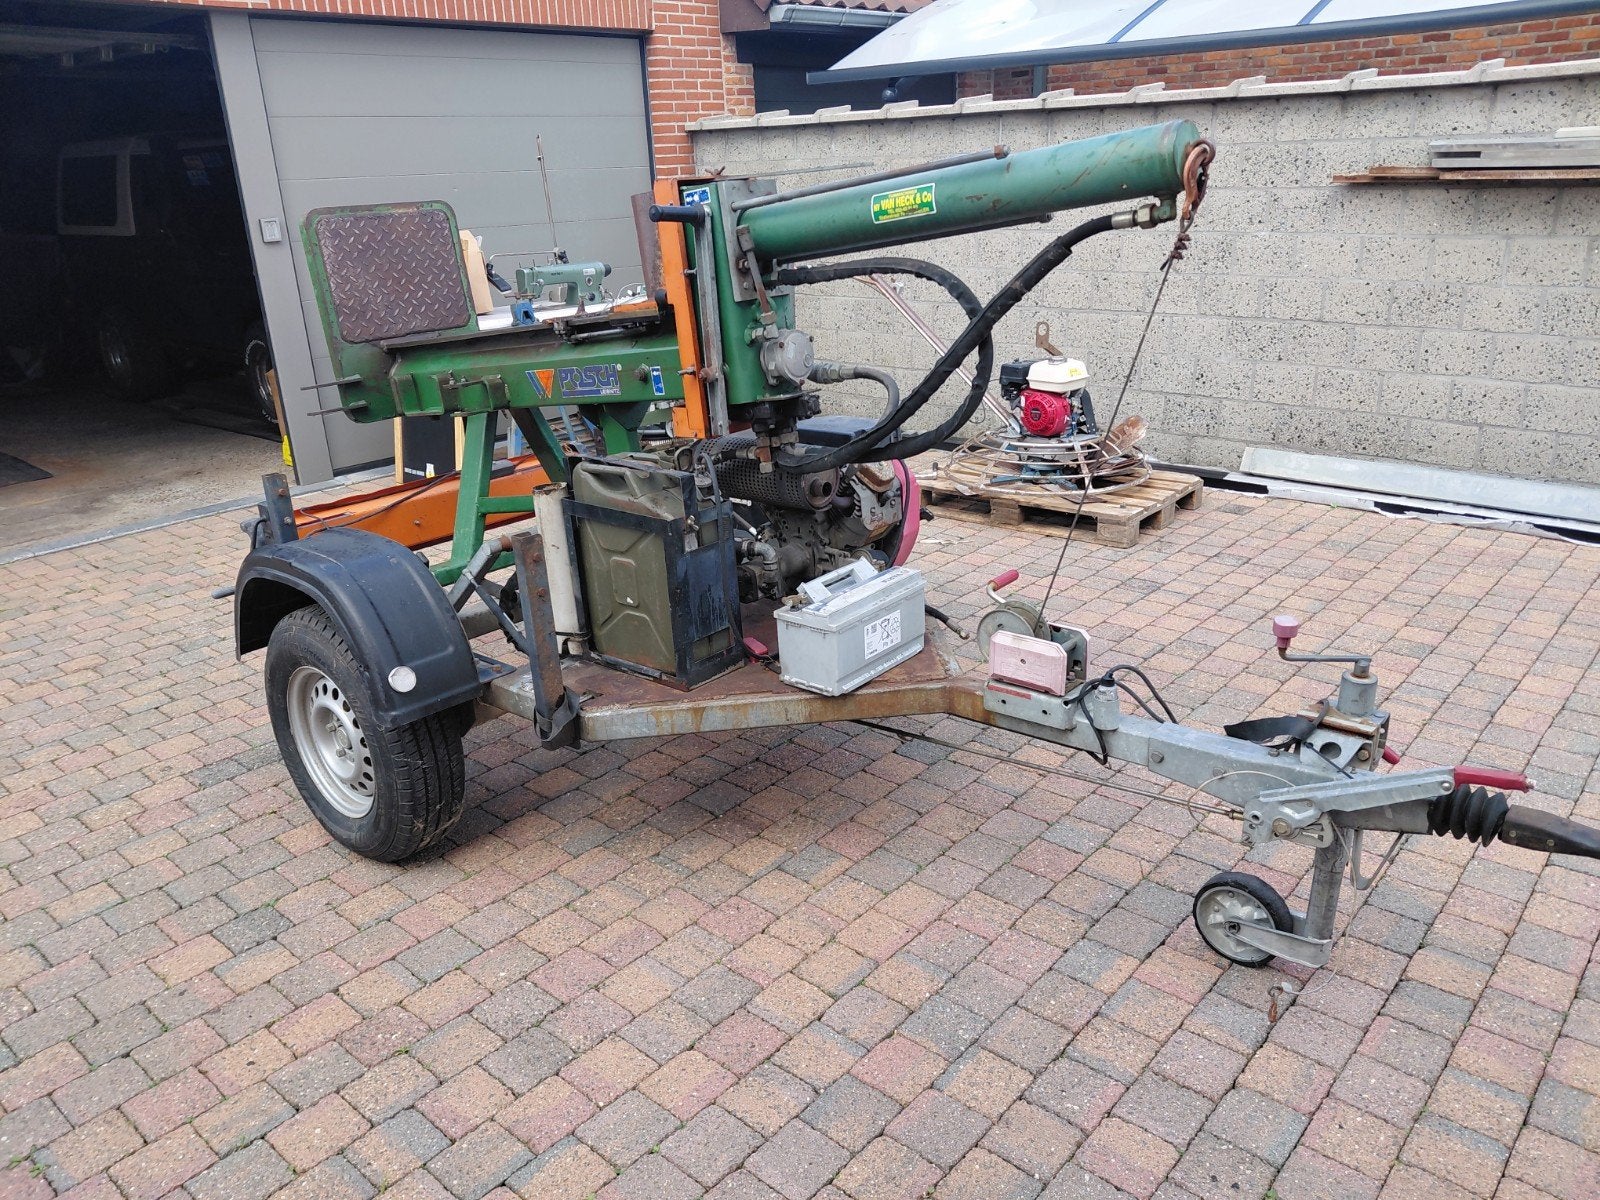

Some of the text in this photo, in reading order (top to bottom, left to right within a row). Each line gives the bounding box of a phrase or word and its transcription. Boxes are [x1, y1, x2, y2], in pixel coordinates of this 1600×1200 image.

[881, 197, 895, 210] VAN
[896, 193, 916, 207] HECK
[922, 191, 932, 203] Co
[557, 364, 619, 390] POSCH
